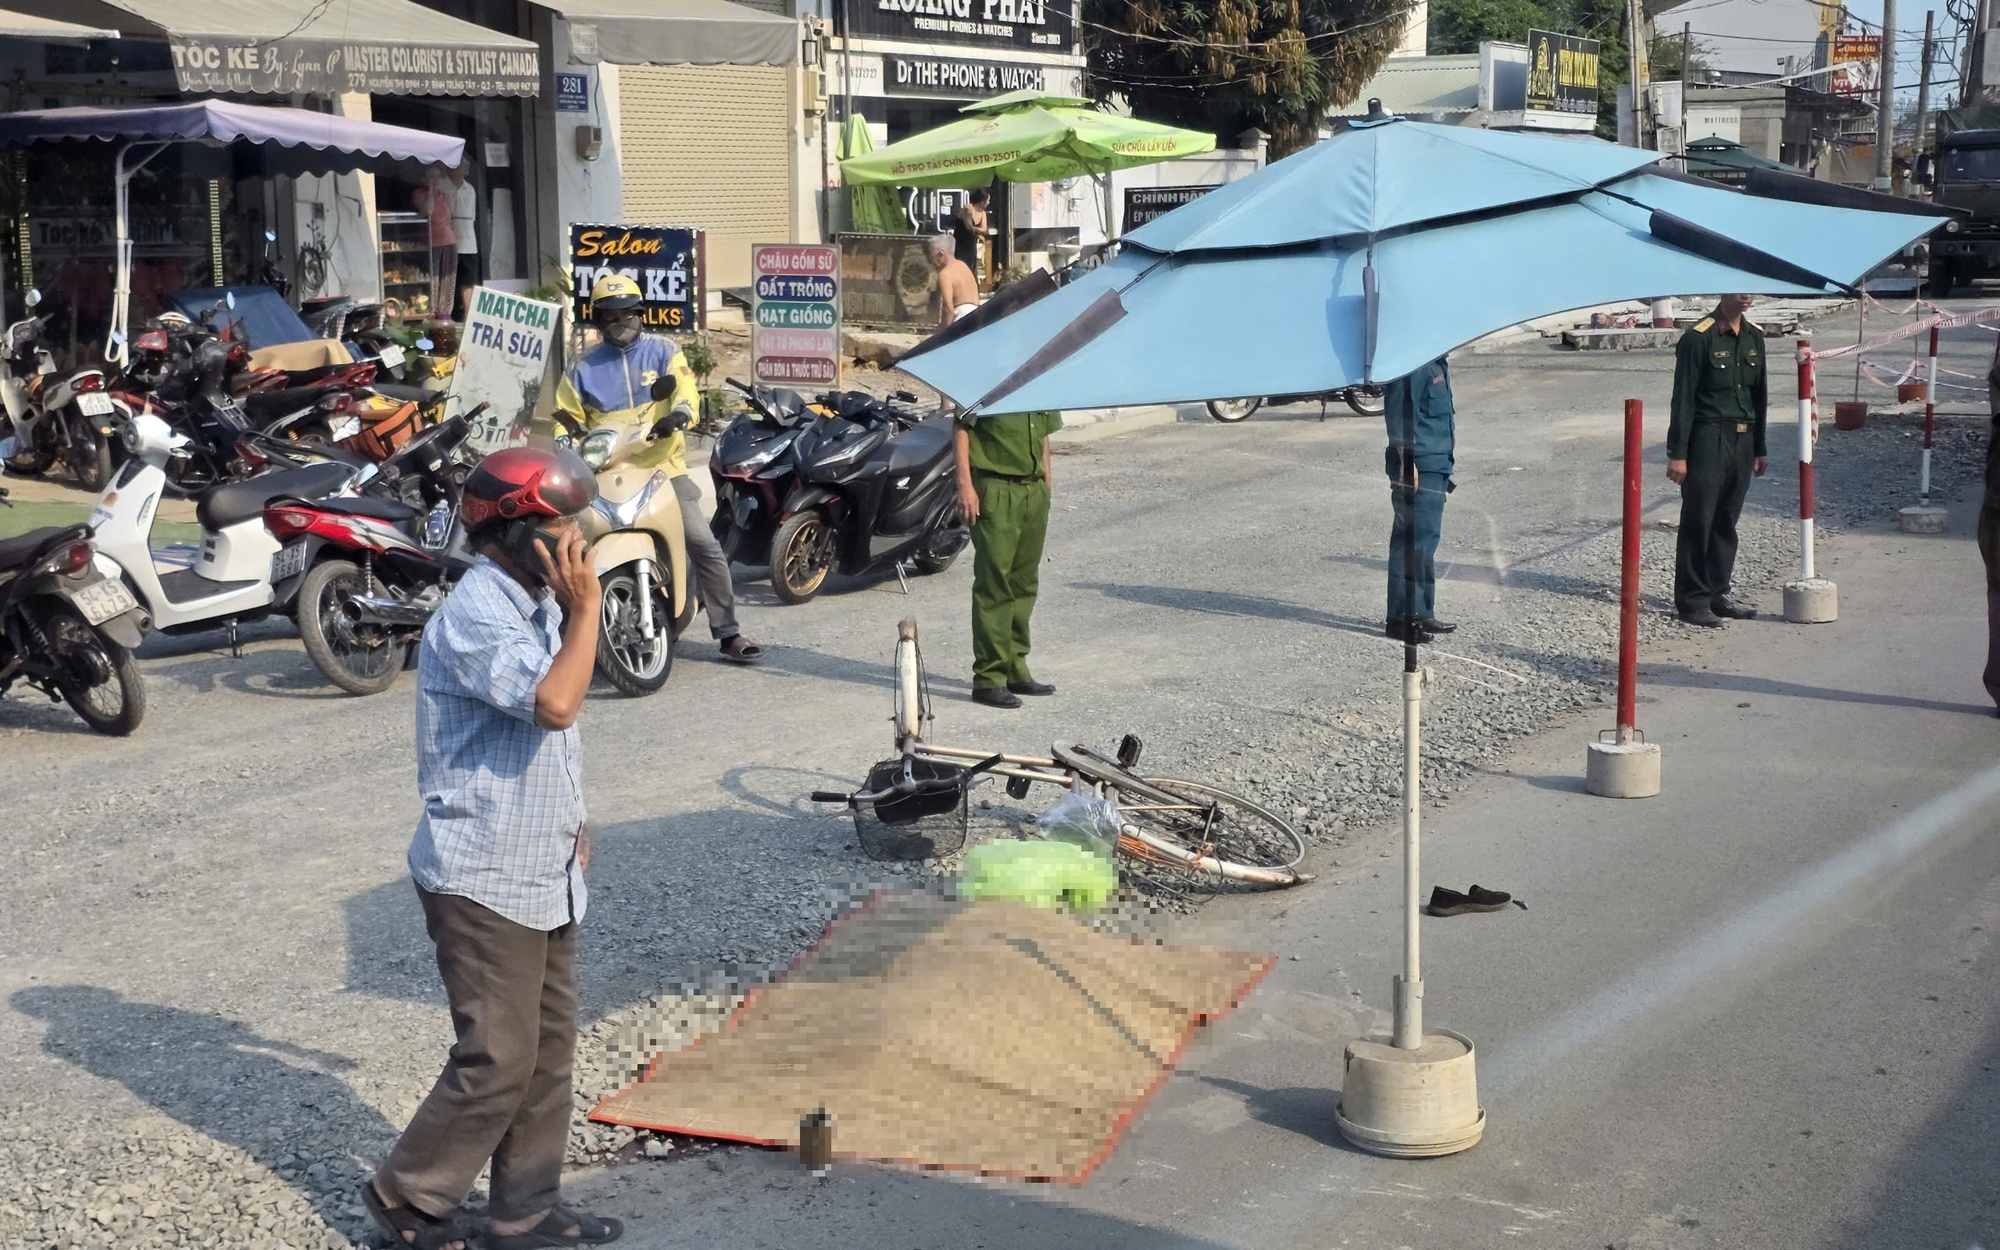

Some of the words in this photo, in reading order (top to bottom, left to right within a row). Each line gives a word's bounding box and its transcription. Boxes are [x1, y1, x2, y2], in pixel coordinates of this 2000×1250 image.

[914, 17, 948, 31] PREMIUM
[949, 20, 976, 34] PHONES
[977, 23, 983, 35] &
[983, 23, 1014, 38] WATCHES
[344, 46, 390, 71] MASTER
[391, 47, 443, 74] COLORIST
[446, 50, 454, 74] &
[456, 51, 497, 75] STYLIST
[499, 52, 540, 77] CANADA
[349, 73, 366, 88] 279
[562, 76, 582, 93] 281
[897, 60, 913, 83] Dr
[914, 62, 938, 86] THE
[940, 64, 984, 88] PHONE
[989, 67, 998, 89] &
[1000, 68, 1044, 91] WATCH
[1132, 191, 1178, 205] CHÍNH
[1133, 209, 1144, 223] ÉP
[576, 231, 661, 258] Salon
[759, 252, 789, 273] CHẬU
[791, 249, 816, 270] GỐM
[818, 252, 834, 270] SỨ
[645, 253, 687, 302] KỂ
[759, 275, 786, 297] ĐẤT
[788, 276, 833, 299] TRỒNG
[476, 290, 550, 331] MATCHA
[759, 310, 786, 327] HẠT
[790, 302, 833, 325] GIỐNG
[471, 321, 504, 350] TRÀ
[508, 329, 544, 362] SỮA
[90, 594, 130, 620] 6479
